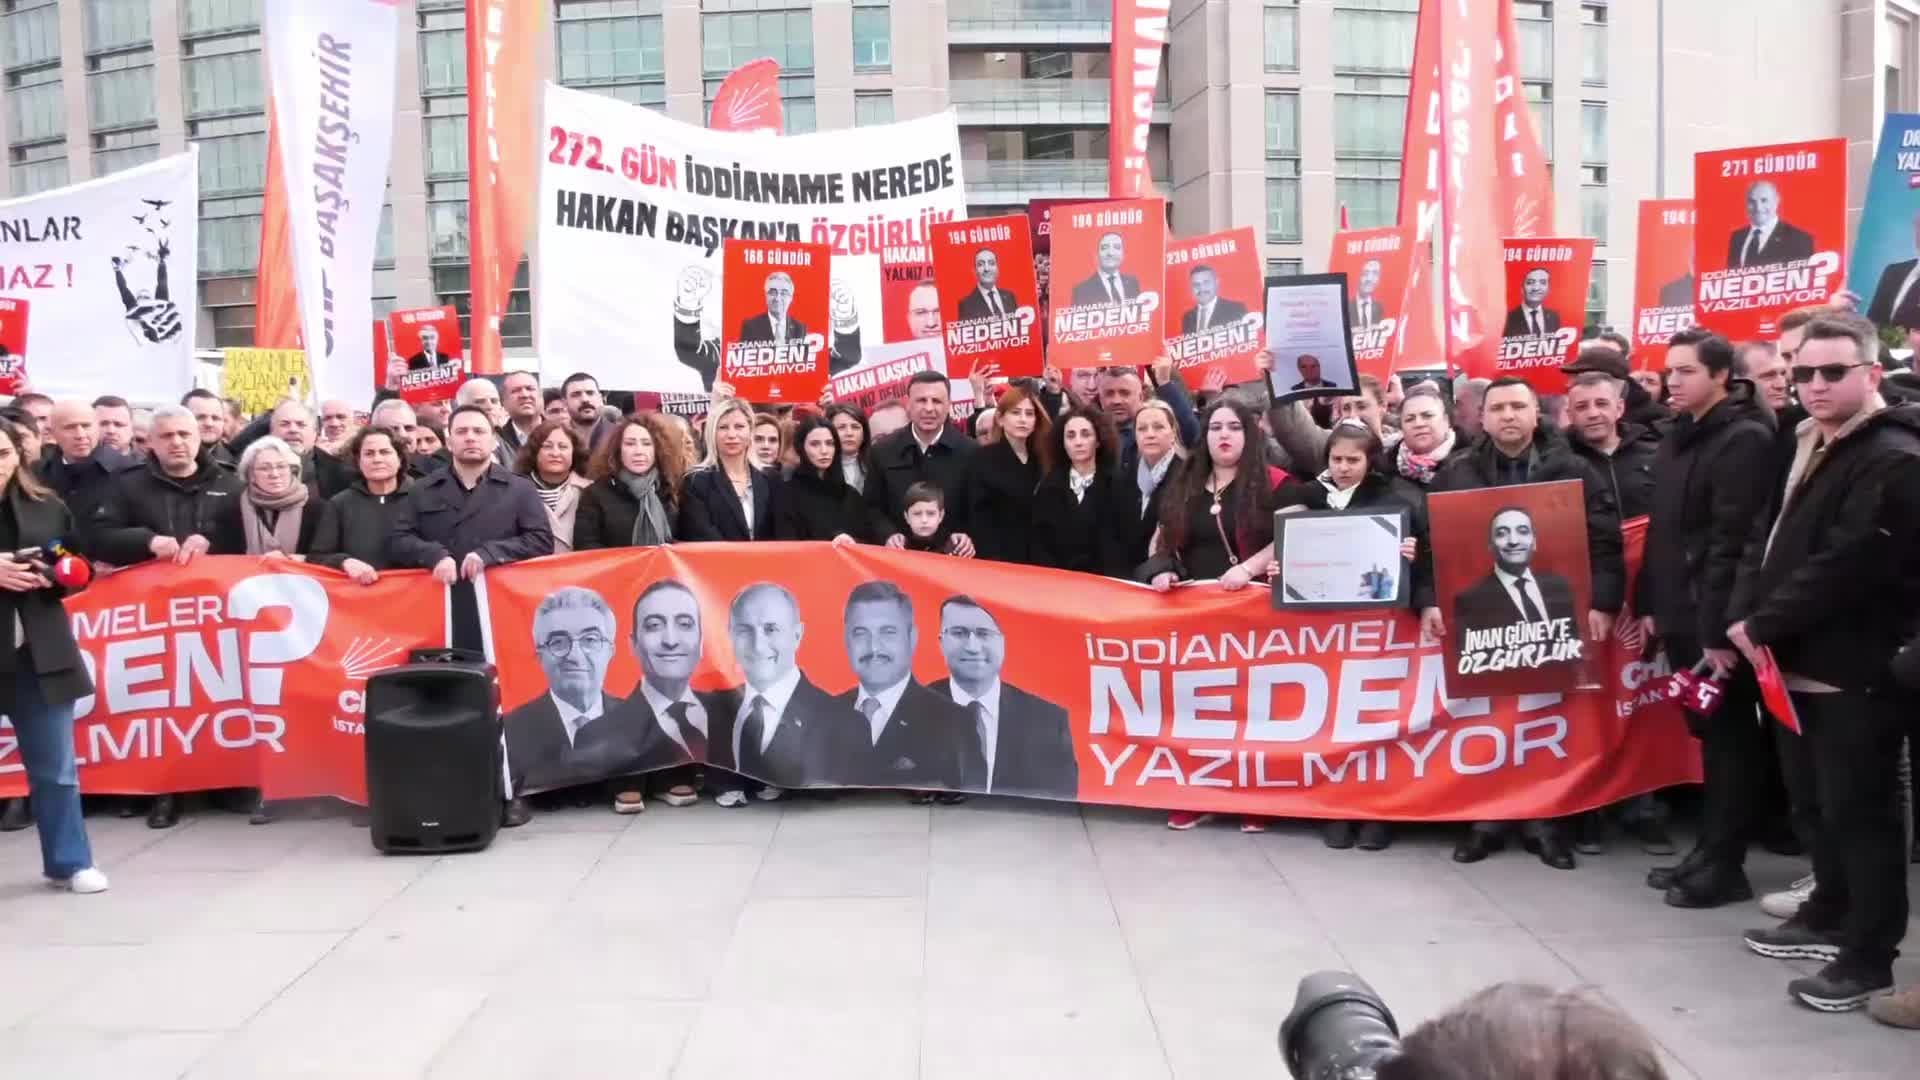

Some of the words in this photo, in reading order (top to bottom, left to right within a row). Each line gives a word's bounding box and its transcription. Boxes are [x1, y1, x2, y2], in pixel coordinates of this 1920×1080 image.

[549, 126, 614, 174] 272.
[621, 143, 678, 190] GÜN
[685, 154, 844, 205] İDDİANAME
[852, 153, 954, 203] NEREDE
[1721, 158, 1748, 177] 271
[1754, 151, 1817, 174] GÜNDÜR
[556, 189, 658, 239] HAKAN
[0, 216, 82, 243] NLAR
[948, 230, 967, 245] 194
[0, 264, 54, 290] AZ
[1700, 288, 1826, 313] YAZILMIYOR
[1637, 313, 1696, 335] NED
[948, 336, 1030, 356] YAZILMIYOR
[726, 363, 817, 379] YAZILMIYOR
[1085, 620, 1441, 664] İDDİANAMEL
[1464, 628, 1503, 653] İNAN
[1457, 639, 1584, 675] ÖZGÜRLÜK
[1089, 716, 1568, 787] YAZILMIYOR
